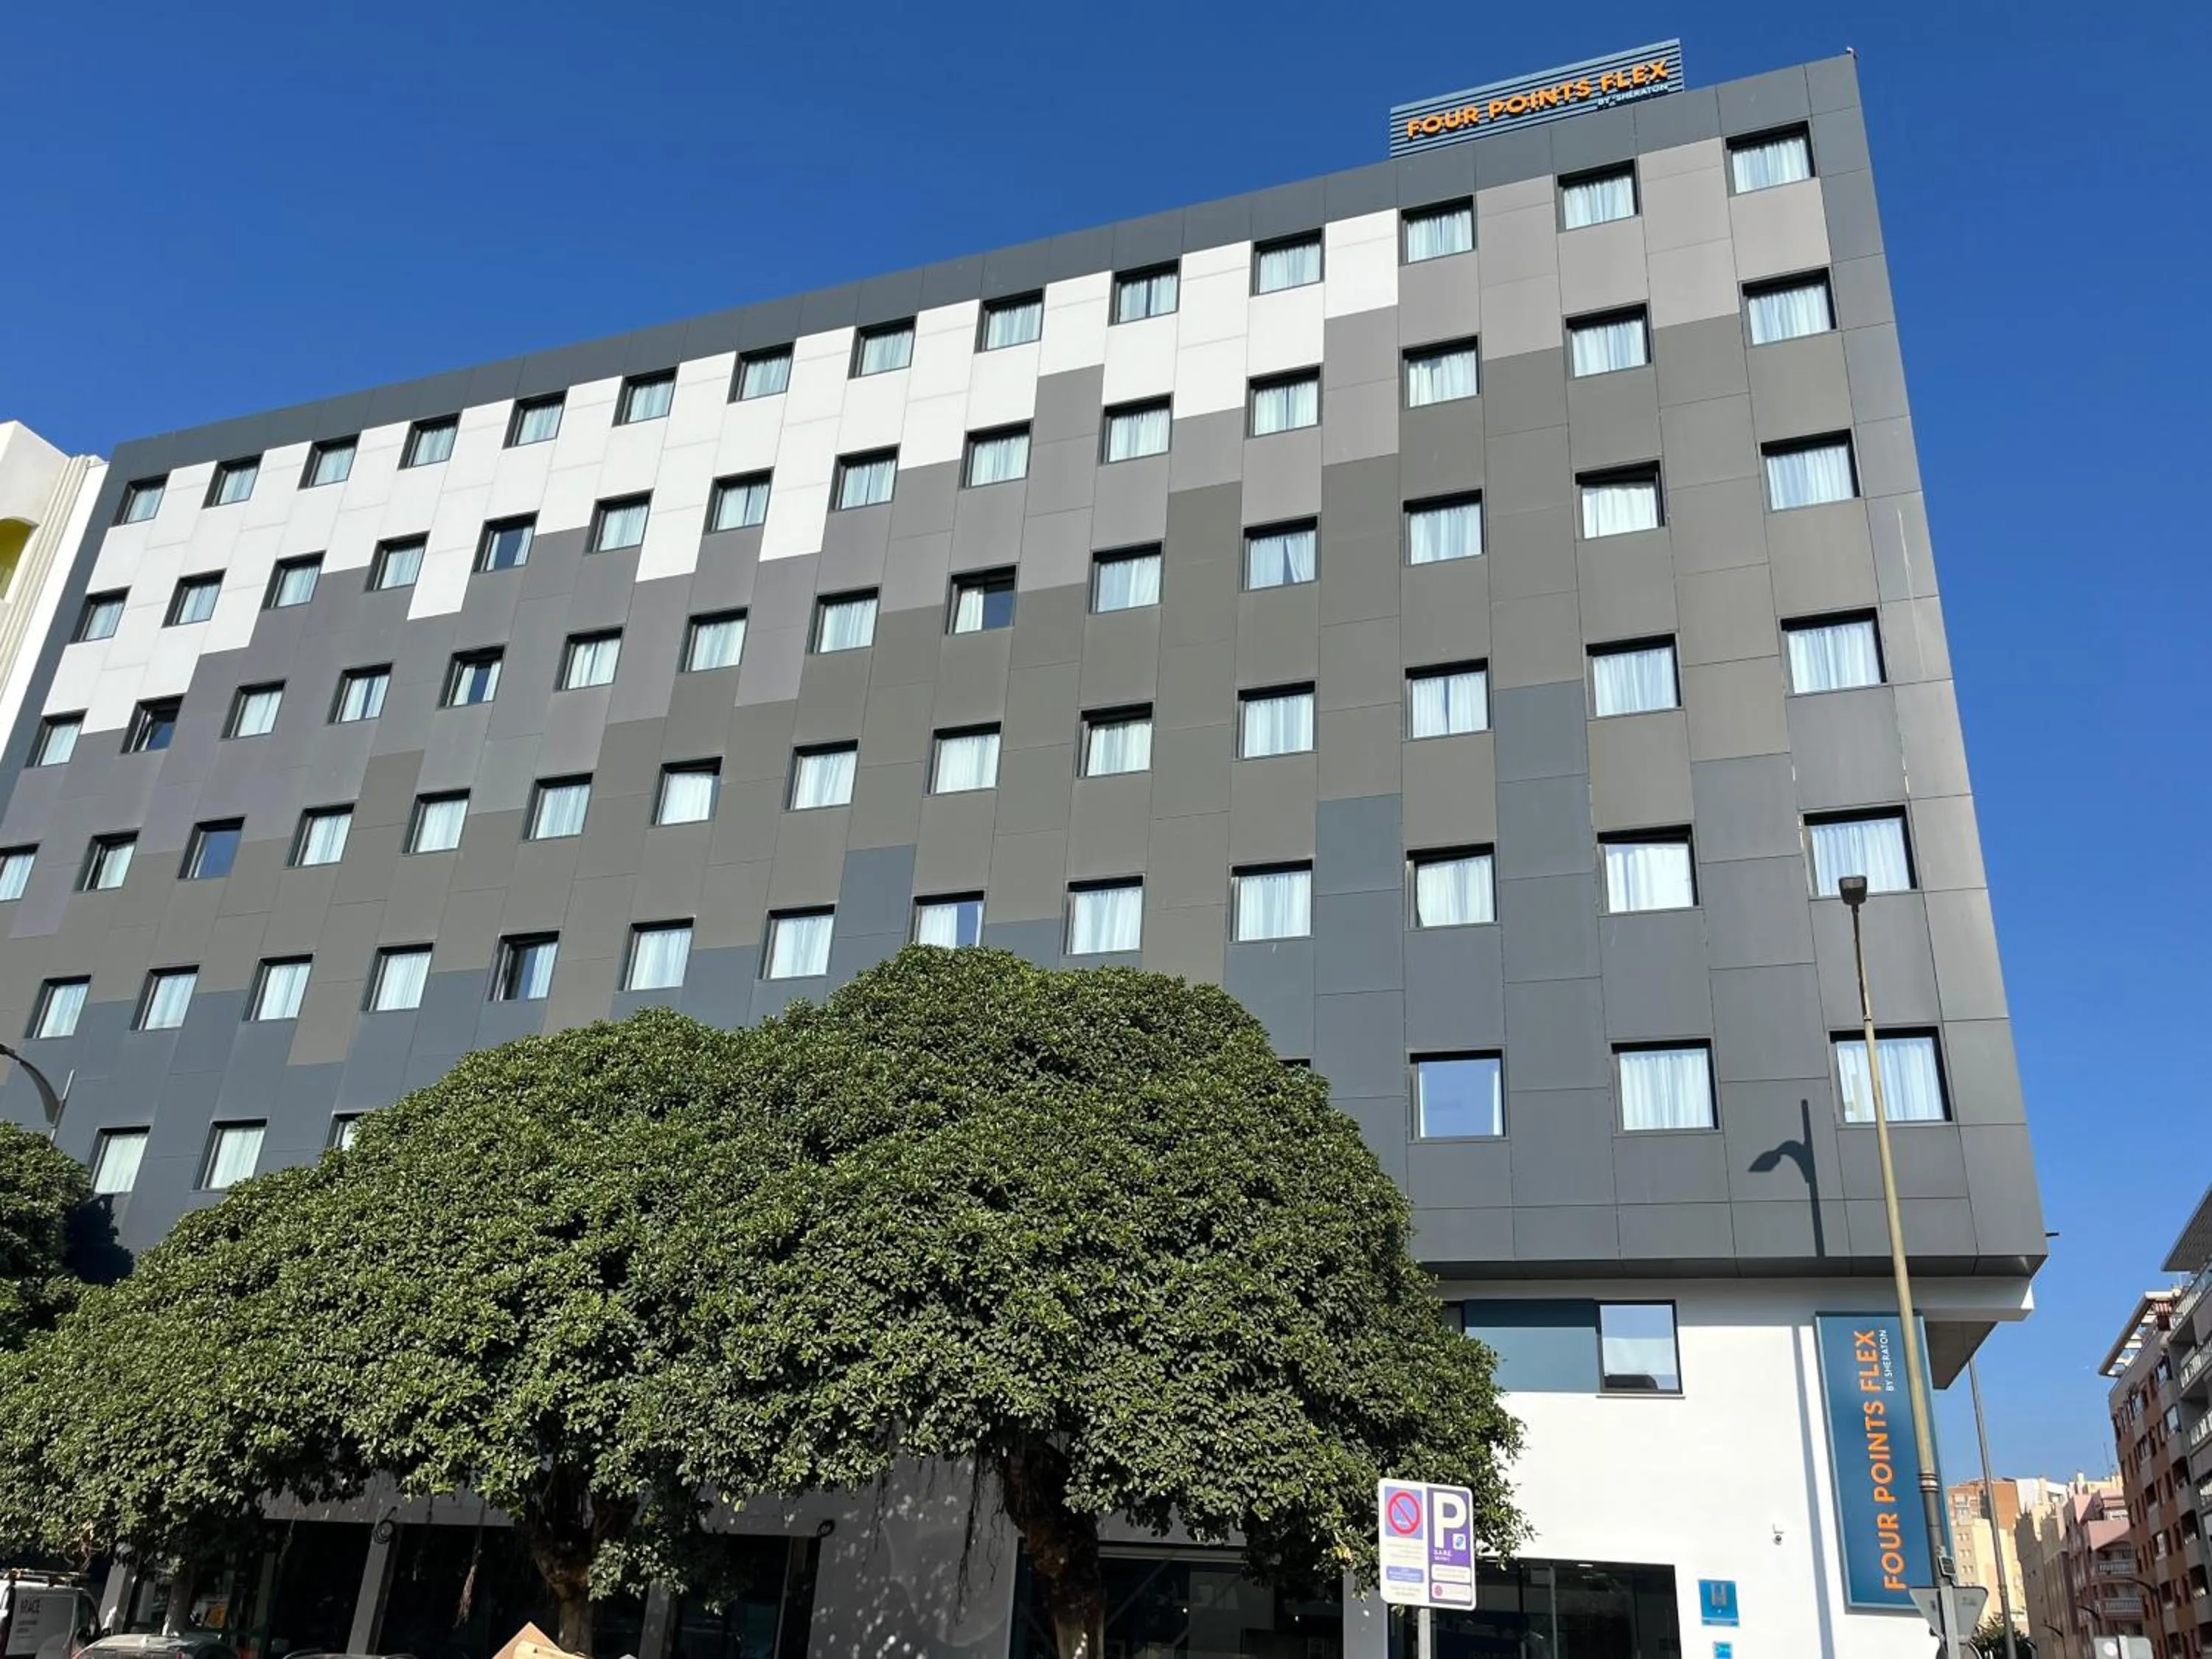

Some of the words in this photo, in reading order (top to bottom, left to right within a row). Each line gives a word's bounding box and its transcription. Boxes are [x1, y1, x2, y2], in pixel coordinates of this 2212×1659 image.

[1407, 109, 1479, 137] FOUR
[1489, 80, 1591, 119] POINTS
[1600, 60, 1668, 94] FLEX
[1598, 97, 1610, 105] BY
[1615, 84, 1669, 101] SHERATON
[1854, 1330, 1881, 1391] FLEX
[1879, 1329, 1893, 1377] SHERATON
[1885, 1380, 1893, 1391] BY
[1863, 1400, 1896, 1503] POINTS
[1433, 1492, 1467, 1548] P
[1875, 1512, 1907, 1590] FOUR
